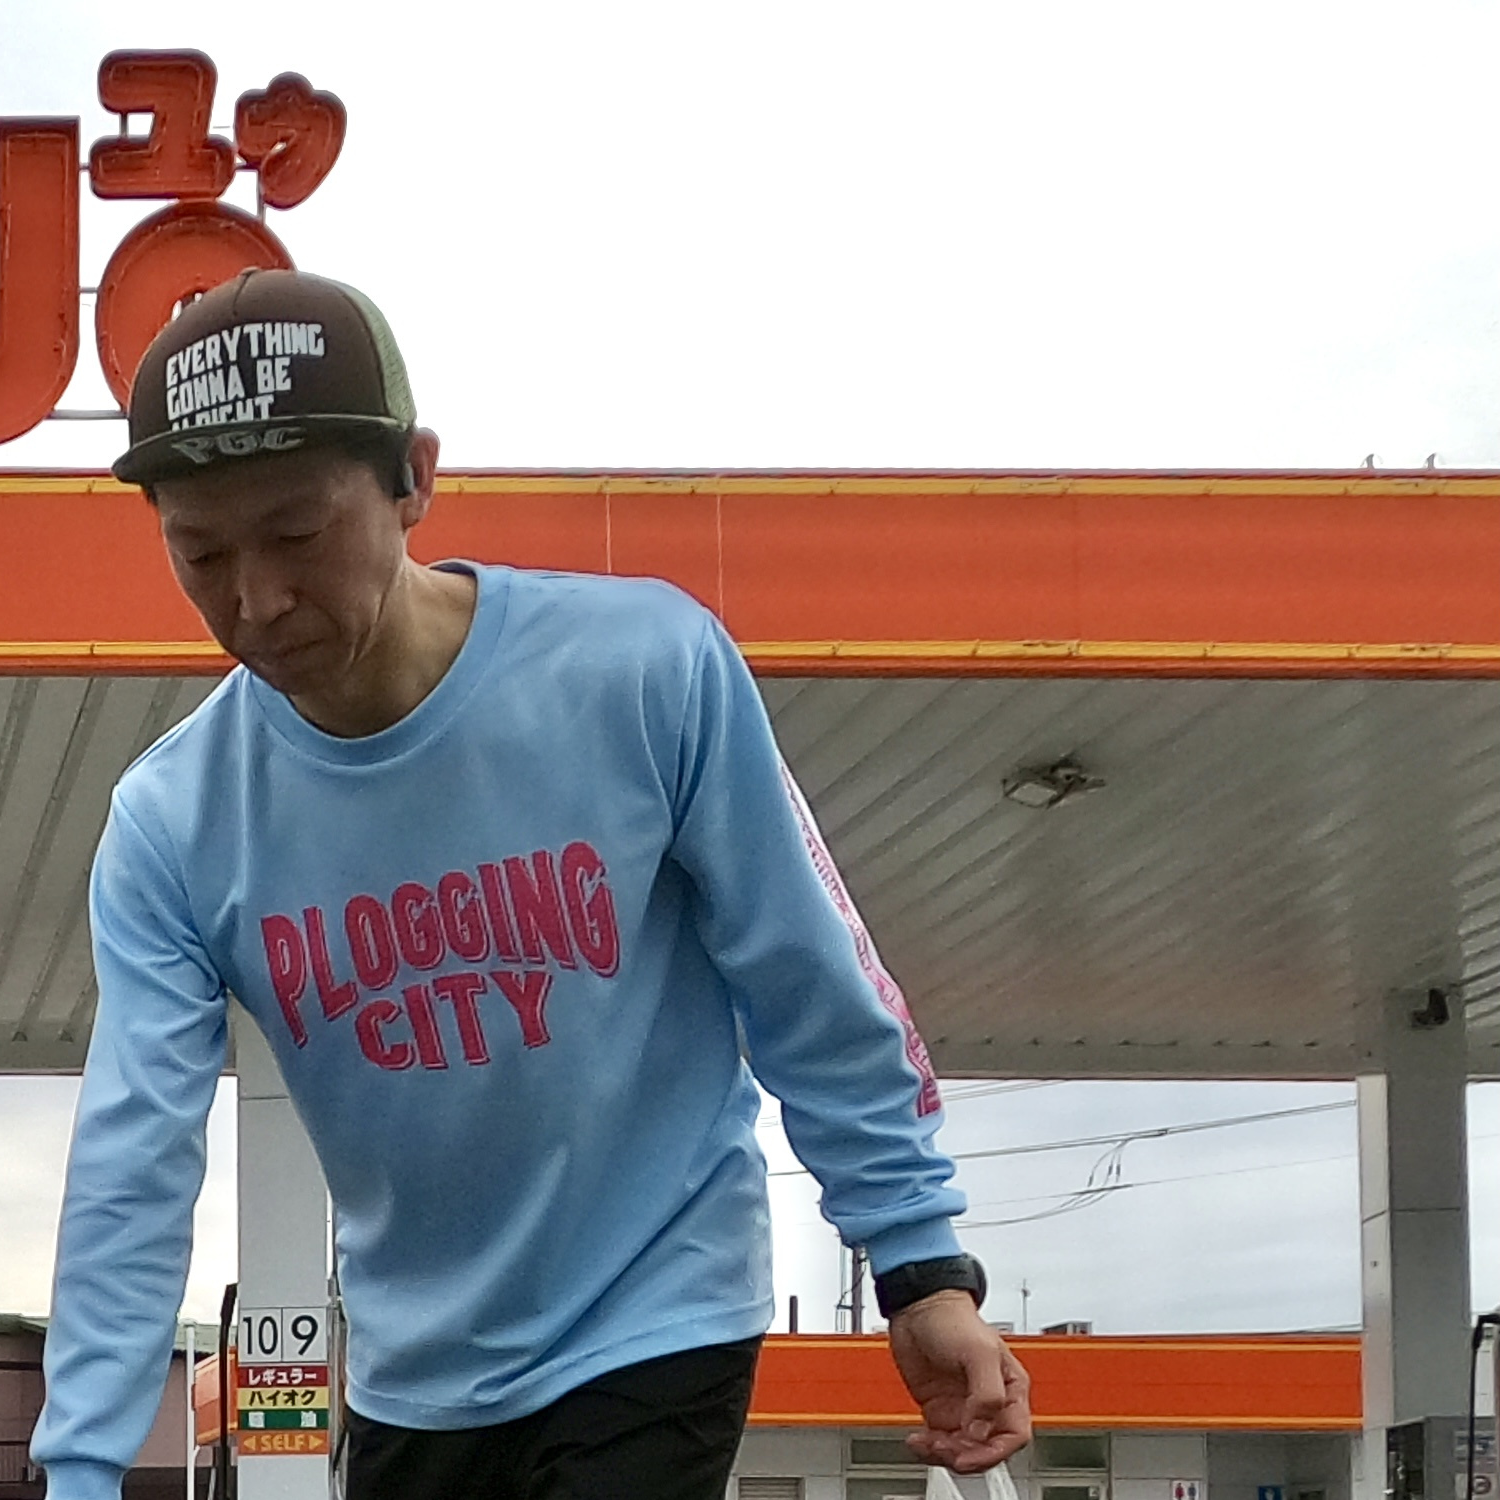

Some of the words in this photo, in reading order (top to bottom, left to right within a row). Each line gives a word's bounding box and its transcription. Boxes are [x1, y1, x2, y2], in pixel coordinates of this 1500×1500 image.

[166, 322, 325, 389] EVERYTHING
[167, 364, 246, 421] GONNA
[256, 357, 292, 395] BE
[171, 394, 275, 431] IGHT
[260, 840, 620, 1049] PLOGGING
[355, 969, 554, 1071] CITY
[242, 1315, 278, 1355] 10
[291, 1314, 319, 1356] 9
[248, 1368, 317, 1386] レギュラー
[248, 1389, 317, 1406] ハイオク
[260, 1434, 305, 1451] SELF
